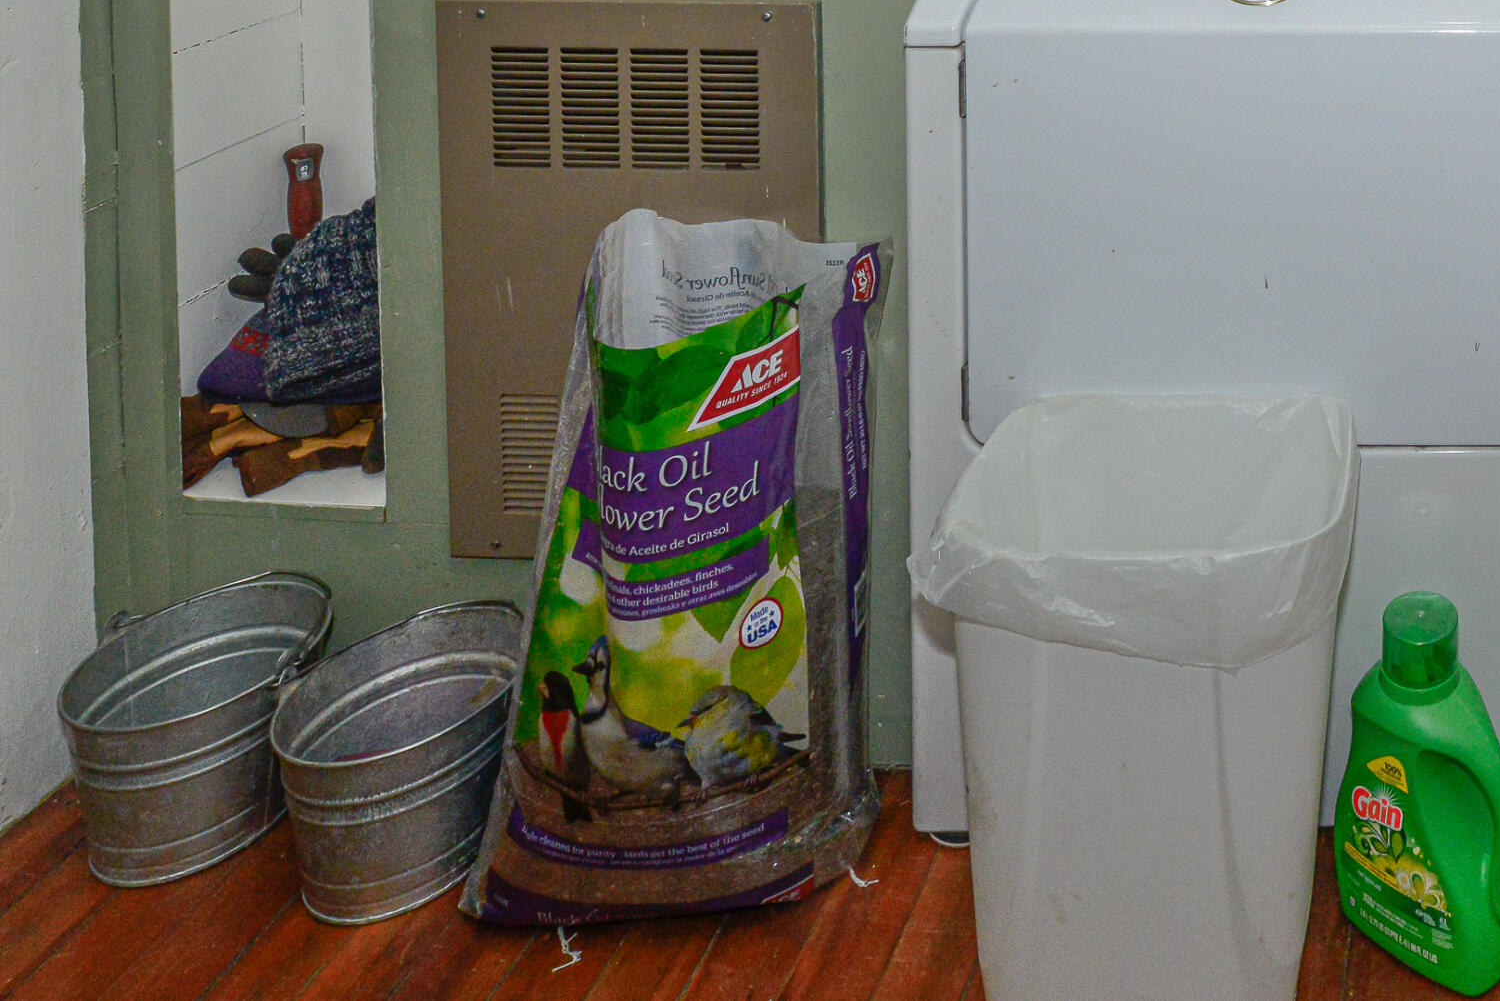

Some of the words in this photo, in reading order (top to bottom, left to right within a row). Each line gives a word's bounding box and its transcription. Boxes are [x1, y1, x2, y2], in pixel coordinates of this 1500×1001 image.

[730, 349, 784, 393] ACE
[715, 391, 749, 409] QUALITY
[751, 380, 772, 397] SINCE
[658, 440, 713, 488] Oil
[683, 459, 761, 523] Seed
[628, 543, 668, 557] Aceite
[669, 537, 685, 551] de
[687, 522, 730, 546] Girasol
[616, 595, 641, 608] other
[642, 588, 690, 607] desirable
[692, 578, 719, 595] birds
[750, 606, 769, 623] Made
[747, 619, 778, 644] USA
[1352, 787, 1403, 831] Gain
[687, 842, 708, 854] best
[709, 838, 721, 849] of
[741, 822, 765, 841] seed
